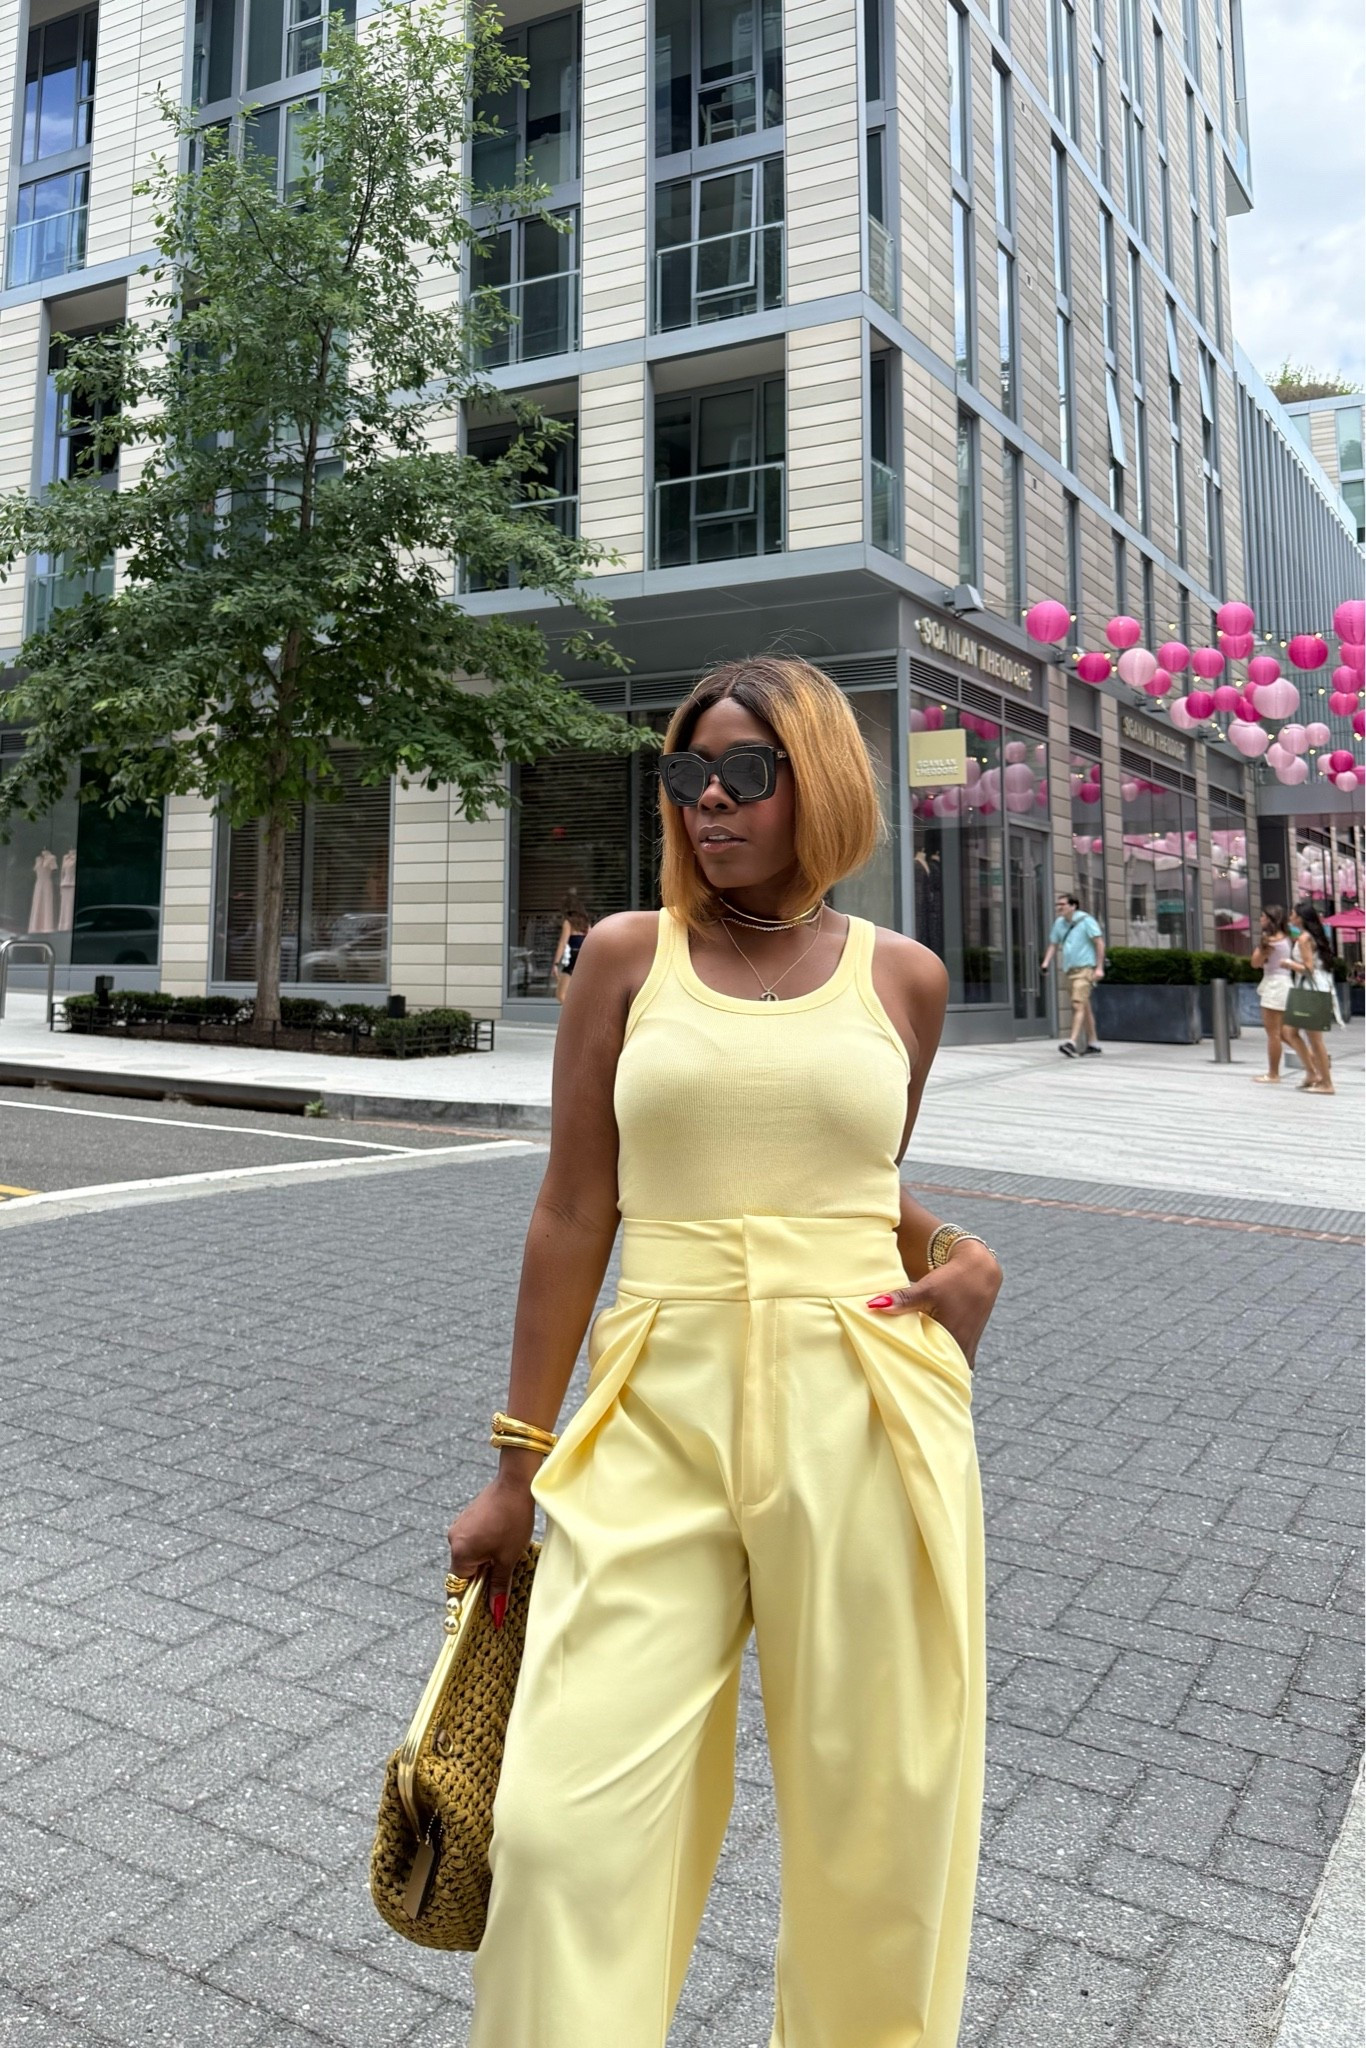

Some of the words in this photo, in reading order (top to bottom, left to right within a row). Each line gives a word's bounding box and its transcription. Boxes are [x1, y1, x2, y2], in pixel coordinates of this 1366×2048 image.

[920, 617, 977, 667] SCANLAN
[979, 645, 1032, 691] THEODORE
[1266, 866, 1276, 877] P
